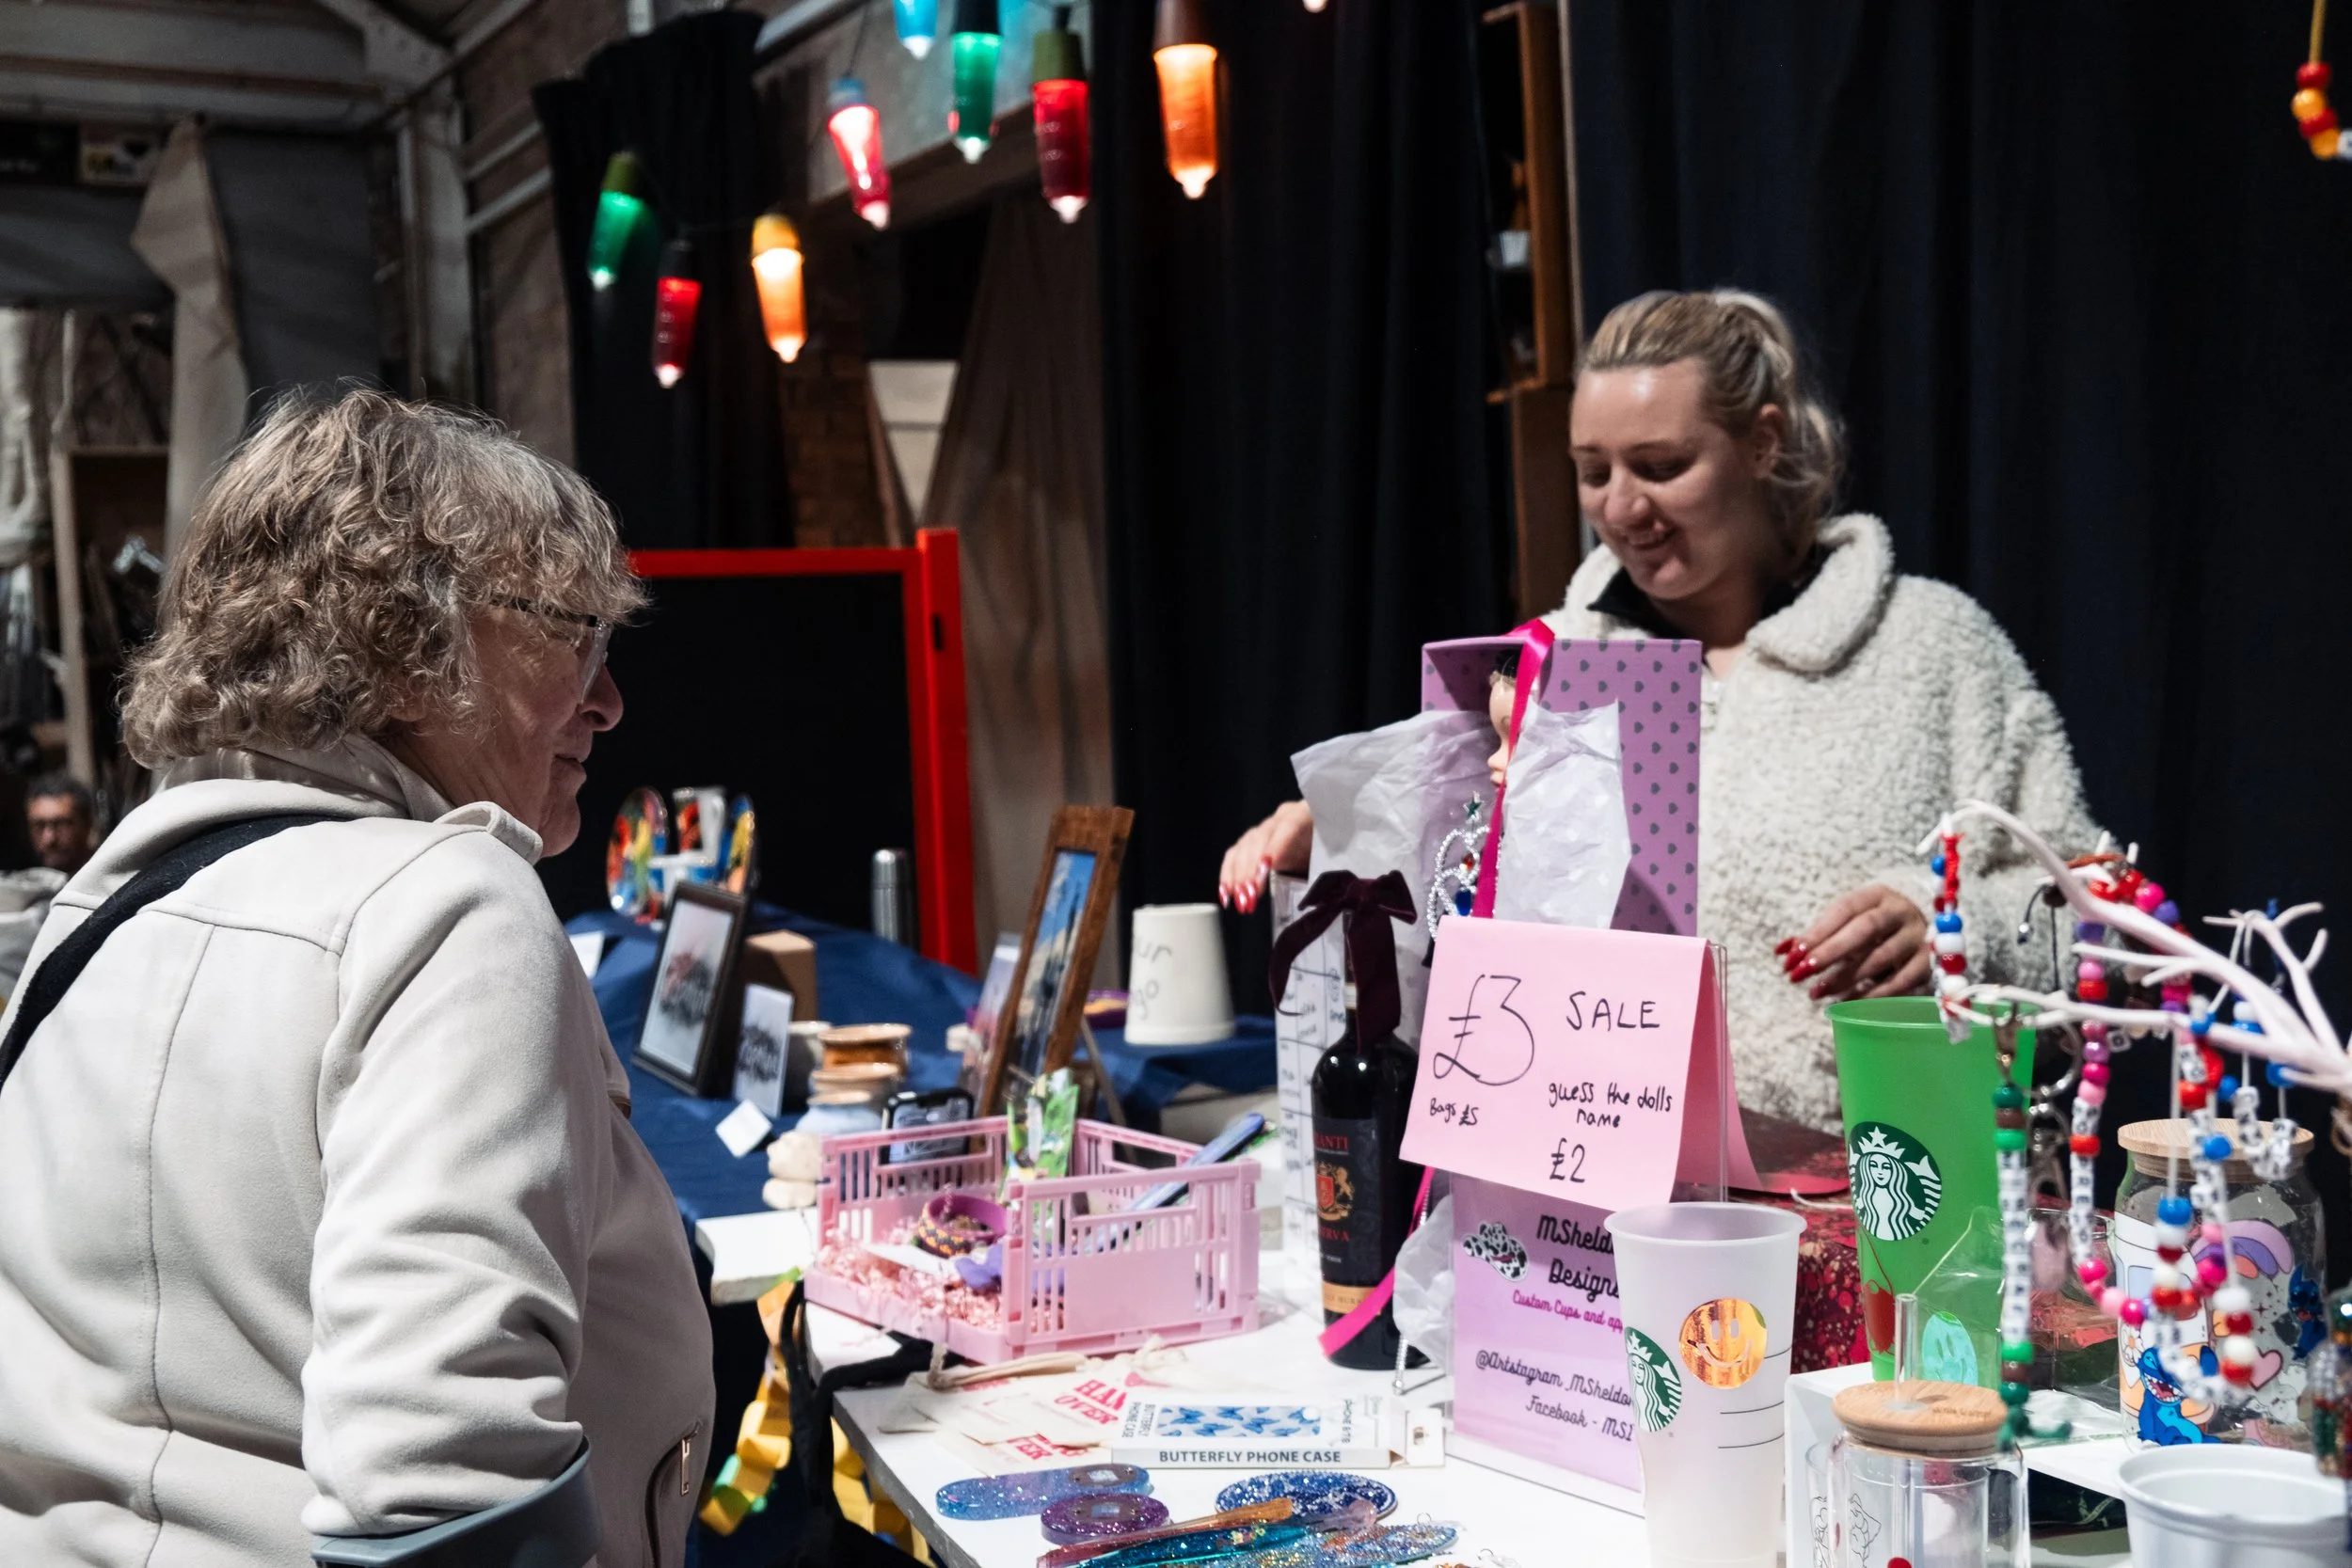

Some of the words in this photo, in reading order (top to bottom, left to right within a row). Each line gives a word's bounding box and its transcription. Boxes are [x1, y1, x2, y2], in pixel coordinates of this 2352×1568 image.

[1565, 990, 1660, 1031] SALE
[1433, 974, 1534, 1086] £3
[1429, 1097, 1456, 1125] Bags
[1458, 1105, 1479, 1126] £5
[1548, 1081, 1594, 1108] guess
[1607, 1081, 1629, 1105] the
[1637, 1085, 1673, 1113] dolls
[1576, 1107, 1621, 1129] name
[1314, 1132, 1348, 1151] ANTI
[1549, 1137, 1585, 1183] £2
[1536, 1213, 1614, 1255] MSheld
[1513, 1289, 1552, 1312] Custom
[1554, 1299, 1581, 1321] Cups
[1583, 1310, 1606, 1325] and
[1608, 1316, 1623, 1334] ap
[1565, 1373, 1632, 1406] _MSheldo
[1054, 1395, 1119, 1424] OVER
[1526, 1395, 1587, 1428] Facebook
[1158, 1449, 1242, 1464] BUTTERFLY
[1247, 1449, 1299, 1464] PHONE
[1303, 1449, 1341, 1464] CASE
